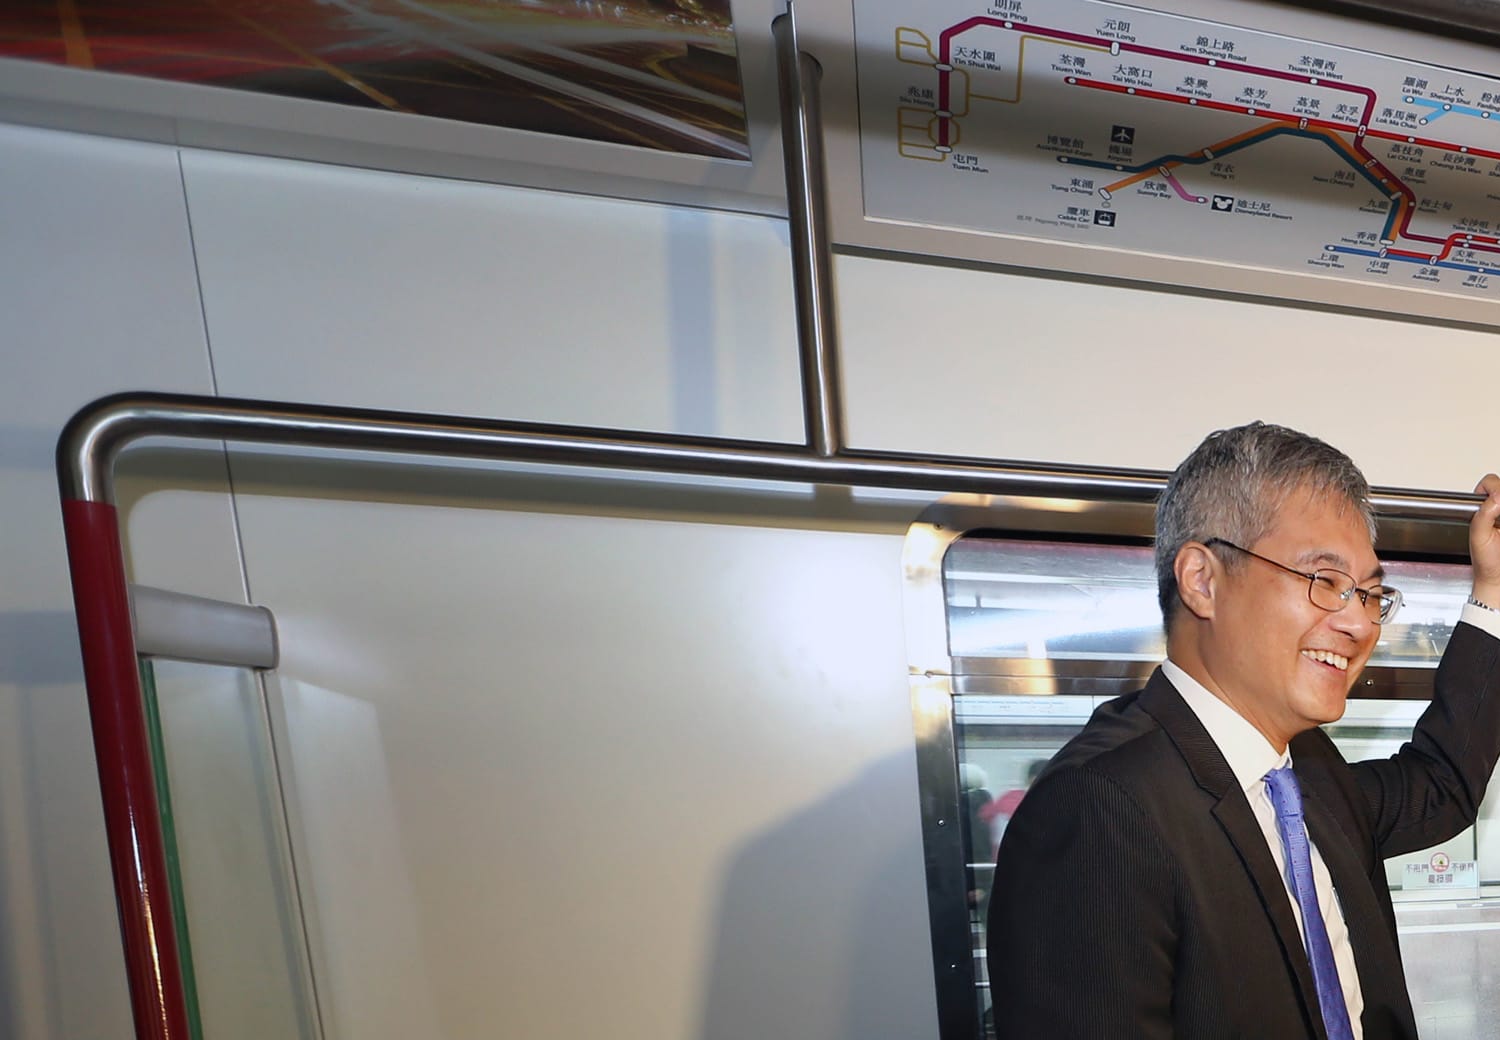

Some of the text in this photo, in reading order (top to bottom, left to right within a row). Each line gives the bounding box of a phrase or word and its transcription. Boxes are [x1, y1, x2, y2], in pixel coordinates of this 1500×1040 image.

[1096, 28, 1136, 43] Yuen Long
[954, 57, 1001, 71] Tin Shui Wai
[1074, 68, 1092, 77] Wan
